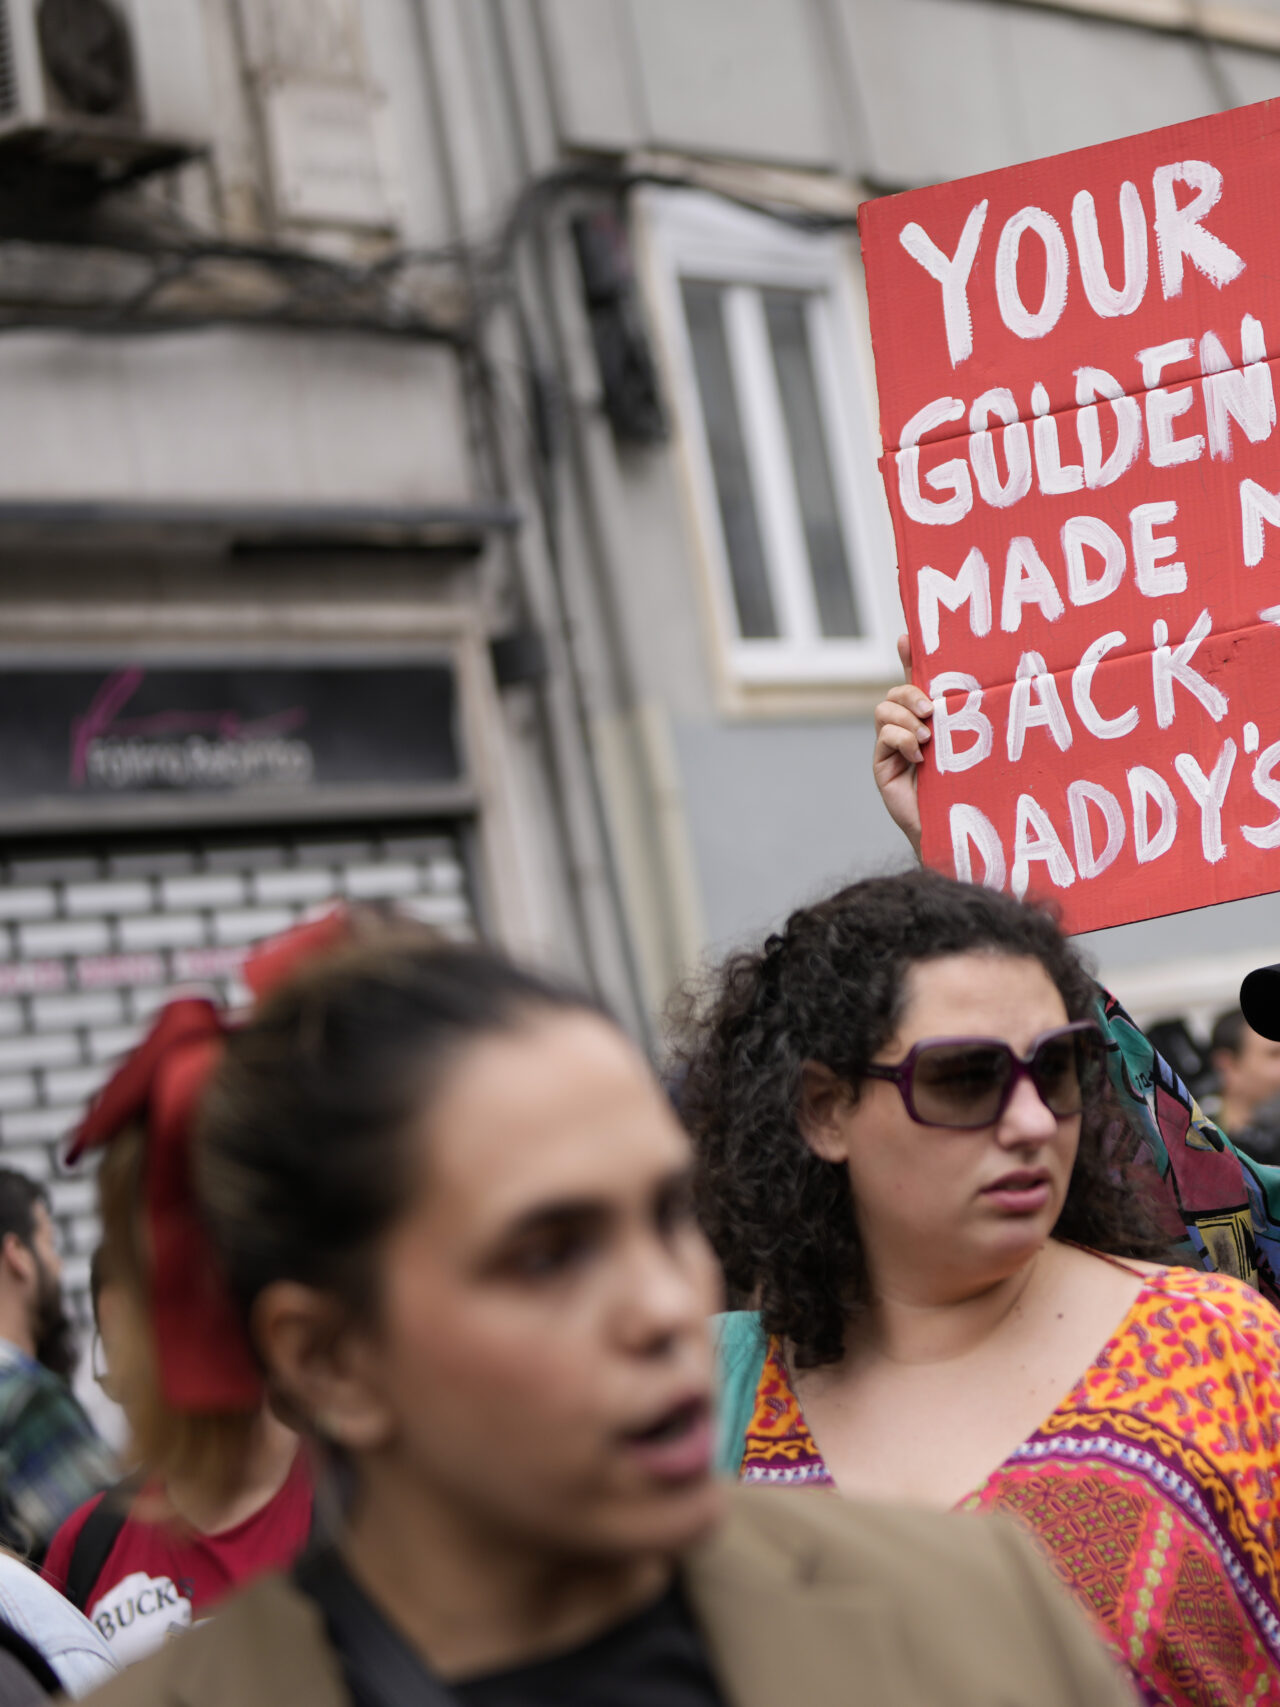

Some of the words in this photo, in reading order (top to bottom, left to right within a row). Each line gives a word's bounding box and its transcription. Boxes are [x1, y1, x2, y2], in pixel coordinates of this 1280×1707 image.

[899, 160, 1246, 370] YOUR
[895, 313, 1277, 526] GOLDEN
[917, 501, 1189, 655] MADE
[929, 608, 1230, 776] BACK
